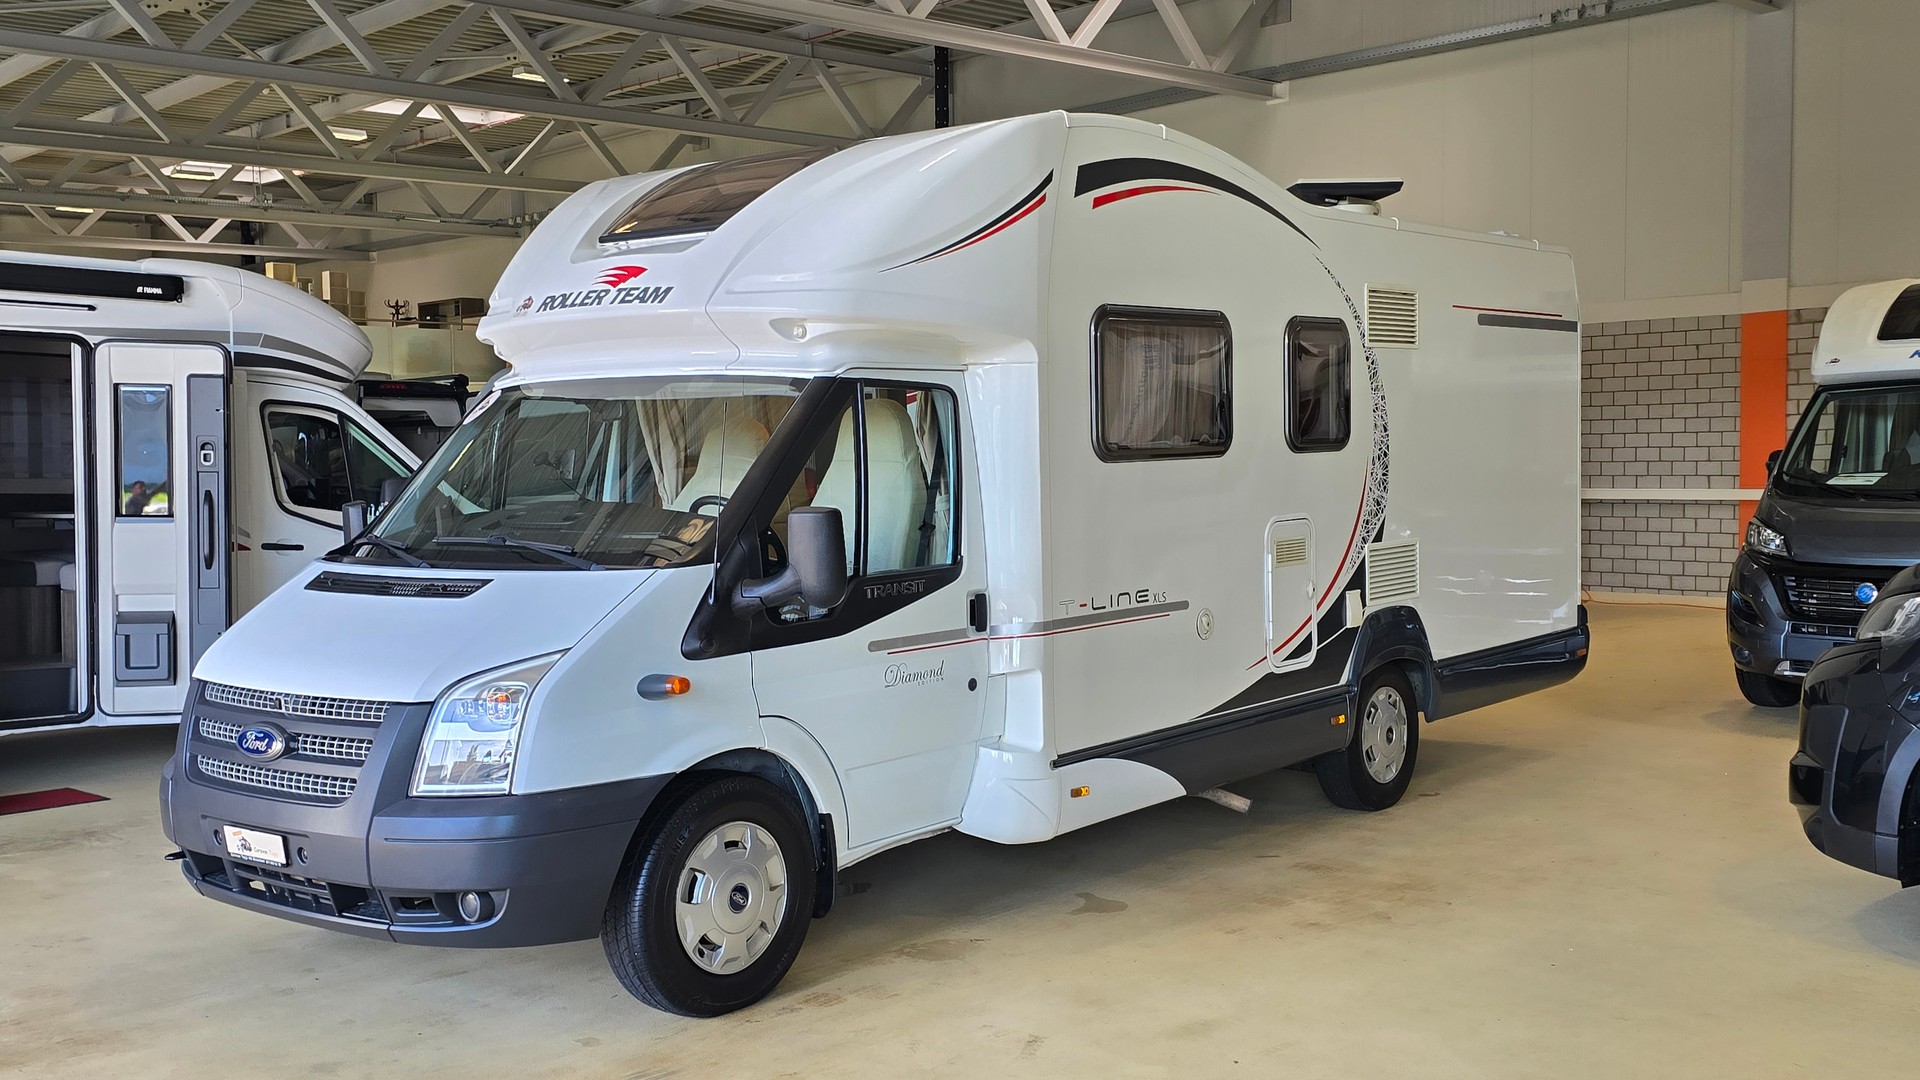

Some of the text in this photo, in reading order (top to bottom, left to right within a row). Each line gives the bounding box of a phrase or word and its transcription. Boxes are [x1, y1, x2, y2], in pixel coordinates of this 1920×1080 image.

[535, 286, 674, 314] ROLLER TEAM
[863, 579, 926, 599] TRANSIT
[1152, 591, 1167, 604] XLS
[884, 659, 944, 688] Diamond
[917, 677, 944, 687] EDITION
[242, 730, 269, 752] Ford
